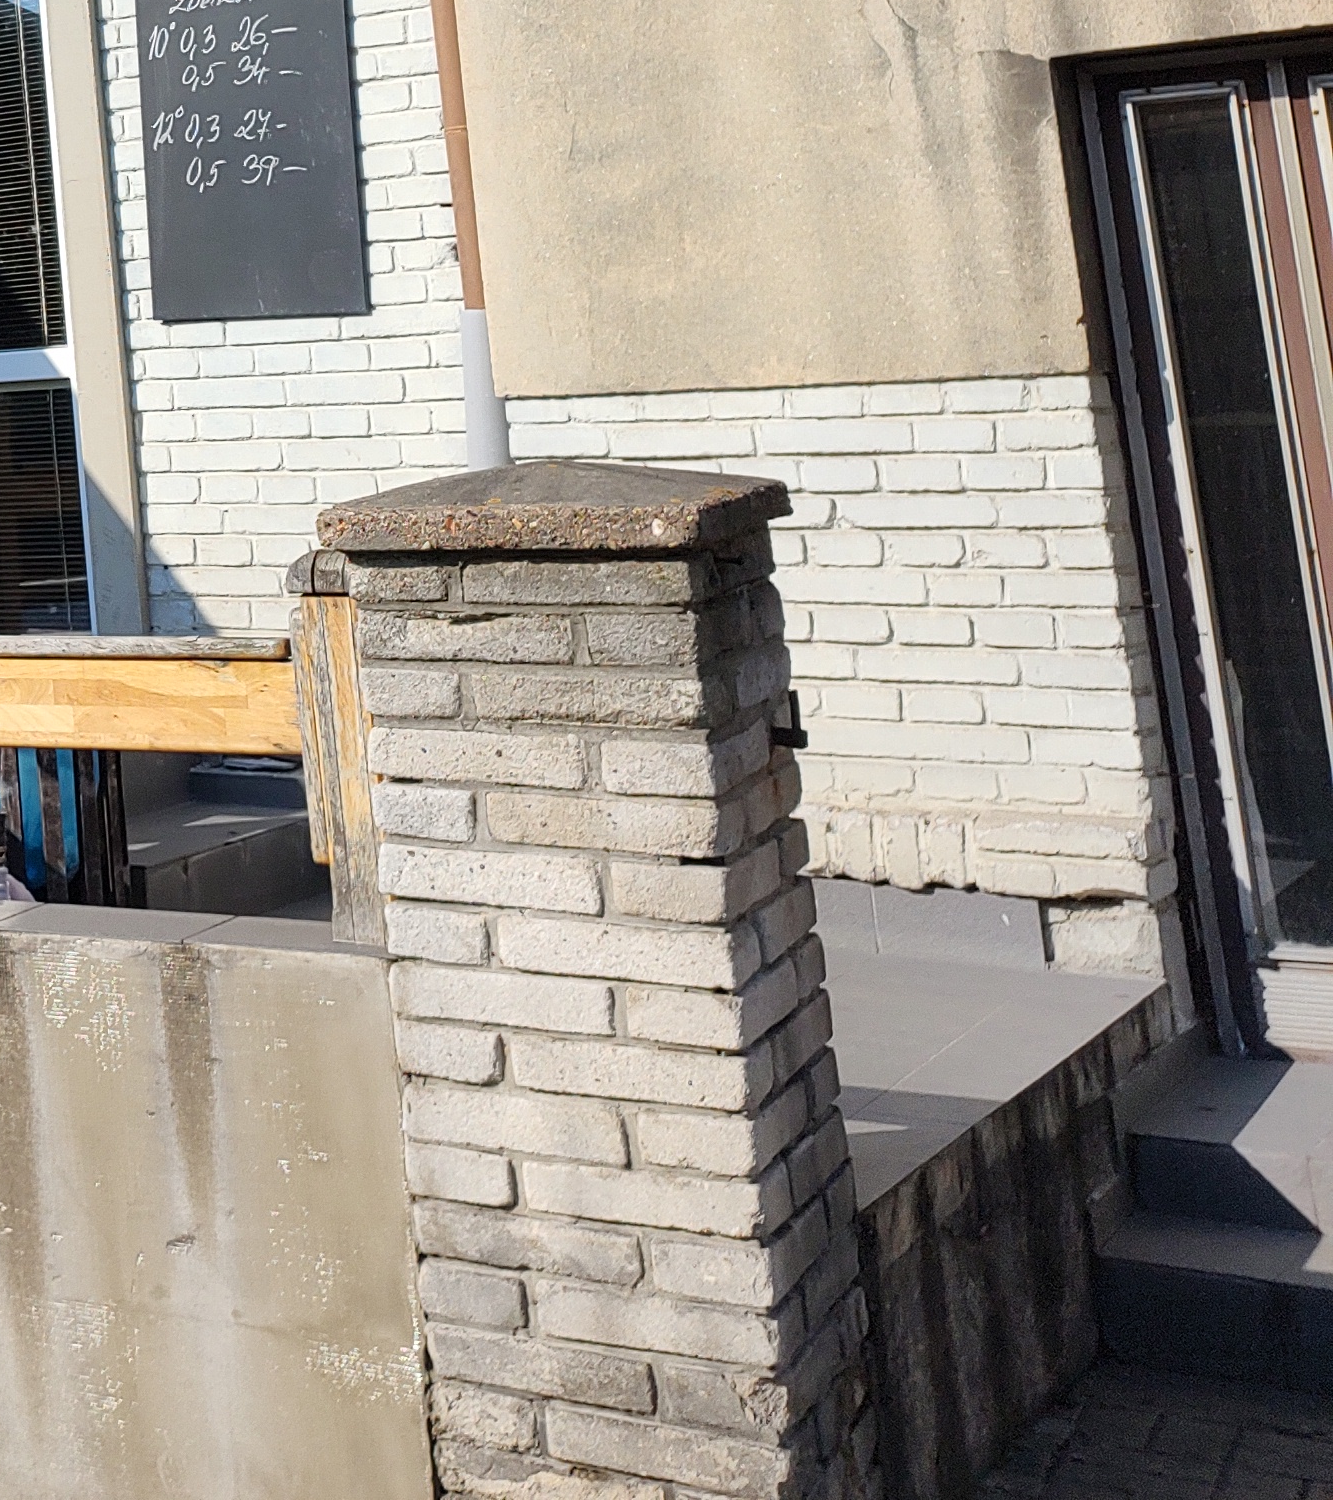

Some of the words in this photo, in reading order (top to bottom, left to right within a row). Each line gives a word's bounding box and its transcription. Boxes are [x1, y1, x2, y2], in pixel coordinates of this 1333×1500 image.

[180, 24, 216, 60] 0,3
[182, 61, 226, 92] 0,5
[184, 113, 220, 149] 0,3
[186, 156, 227, 193] 0,5
